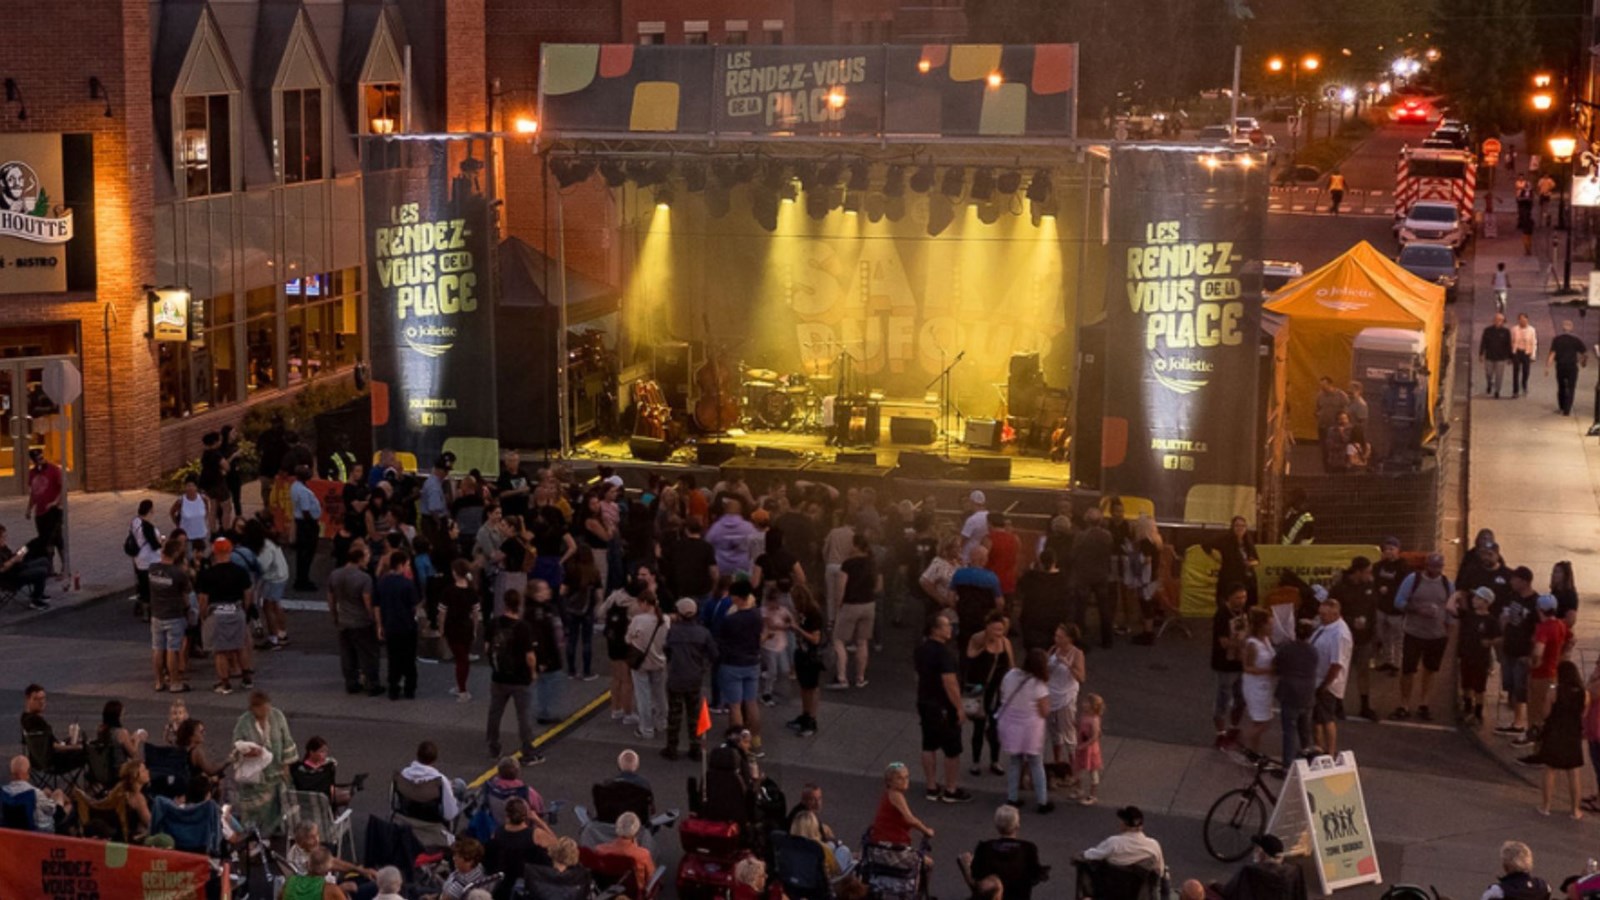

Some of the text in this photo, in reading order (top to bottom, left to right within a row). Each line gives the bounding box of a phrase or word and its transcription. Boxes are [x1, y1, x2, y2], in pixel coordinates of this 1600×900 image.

[727, 51, 751, 69] LES
[725, 56, 866, 96] RENDEZ-VOUS
[2, 213, 68, 237] HOUTTE
[391, 203, 419, 224] LES
[376, 219, 471, 257] RENDEZ-
[1147, 221, 1180, 244] LES
[16, 257, 58, 268] BISTRO
[376, 254, 435, 288] VOUS
[1127, 242, 1242, 279] RENDEZ-
[398, 272, 477, 319] PLACE
[1127, 279, 1236, 313] VOUS DE LA
[418, 326, 457, 337] Joliette
[1147, 302, 1243, 350] PLACE
[1168, 358, 1214, 372] Joliette
